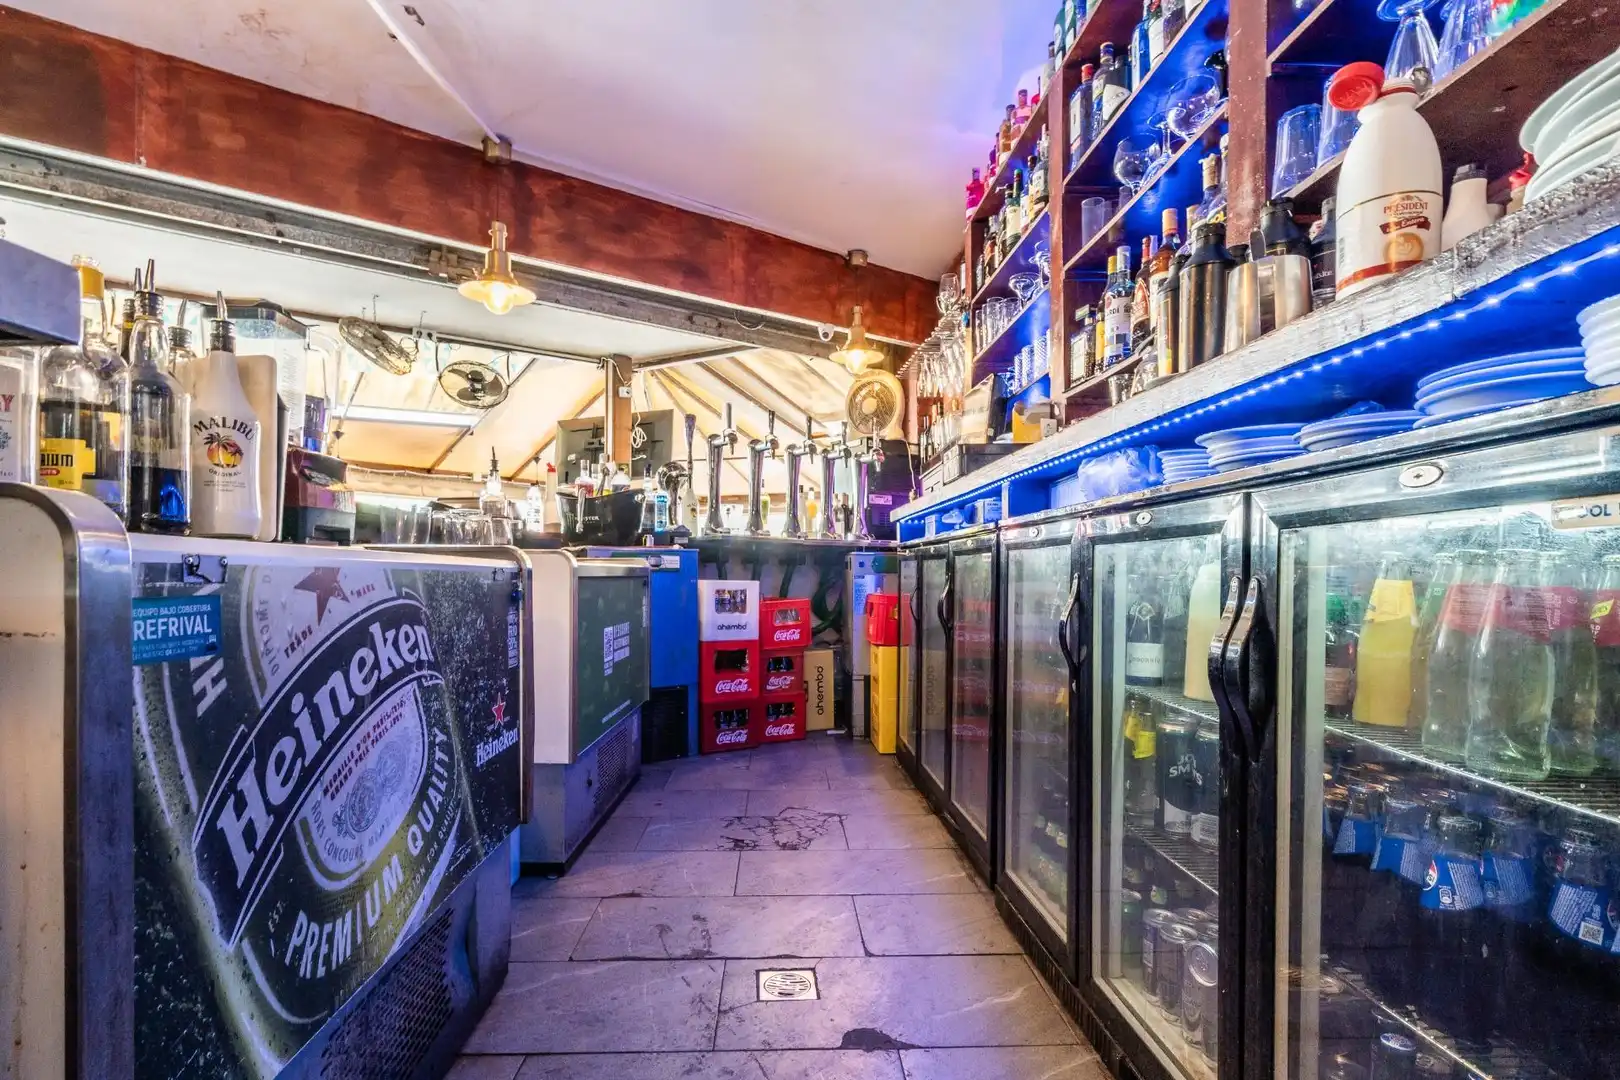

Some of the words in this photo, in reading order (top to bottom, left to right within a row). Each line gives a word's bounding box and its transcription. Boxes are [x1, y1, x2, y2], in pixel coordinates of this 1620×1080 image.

[193, 416, 256, 442] MALIBU
[208, 468, 241, 477] ORIGINAL
[132, 607, 159, 617] EQUIPO
[159, 605, 177, 616] BAJO
[177, 604, 212, 614] COBERTURA
[132, 614, 213, 642] REFRIVAL
[717, 622, 747, 631] ahembo
[283, 624, 314, 659] TRADE
[815, 665, 825, 716] ahembo
[216, 621, 434, 889] Heineken
[475, 727, 519, 768] Heineken
[329, 767, 353, 801] GRAND
[354, 746, 370, 768] PRIX
[310, 800, 326, 838] HORS
[323, 837, 365, 863] CONCOURS
[284, 854, 405, 980] PREMIUM
[406, 726, 451, 857] QUALITY
